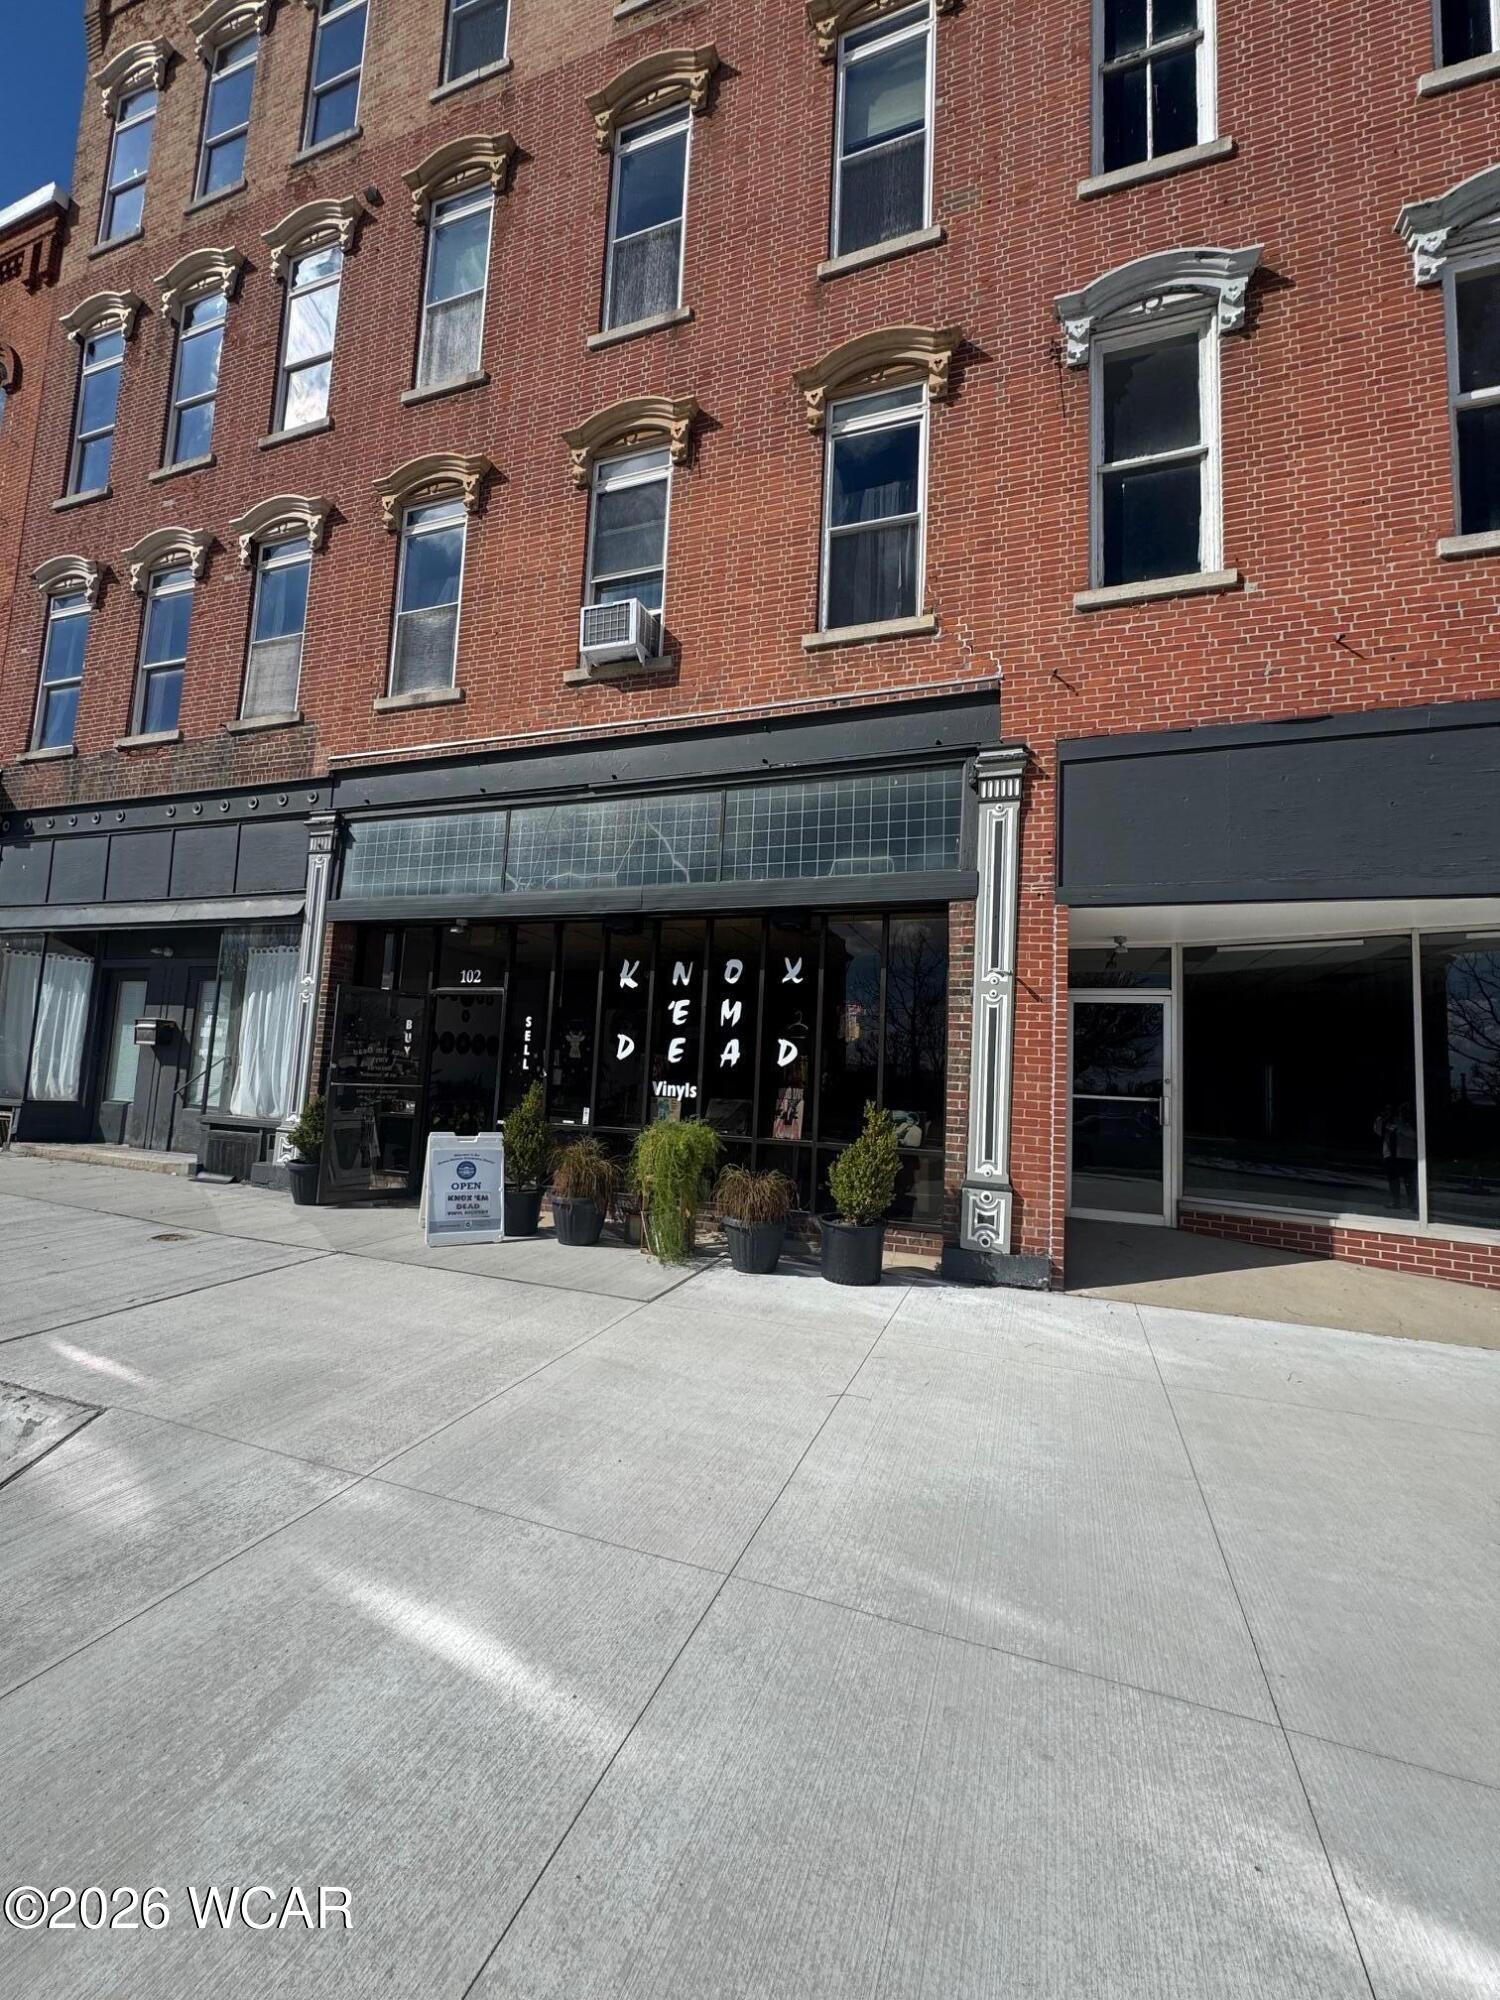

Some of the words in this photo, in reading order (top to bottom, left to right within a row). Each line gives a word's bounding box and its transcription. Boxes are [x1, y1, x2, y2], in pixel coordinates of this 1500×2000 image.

[460, 969, 482, 983] 102
[619, 957, 804, 989] KNOX
[668, 999, 742, 1027] 'EM
[403, 1019, 413, 1055] BUY
[522, 1016, 532, 1070] SELL
[616, 1033, 799, 1068] DEAD
[652, 1080, 698, 1102] Vinyls
[447, 1194, 473, 1202] KNOX
[451, 1182, 482, 1190] OPEN
